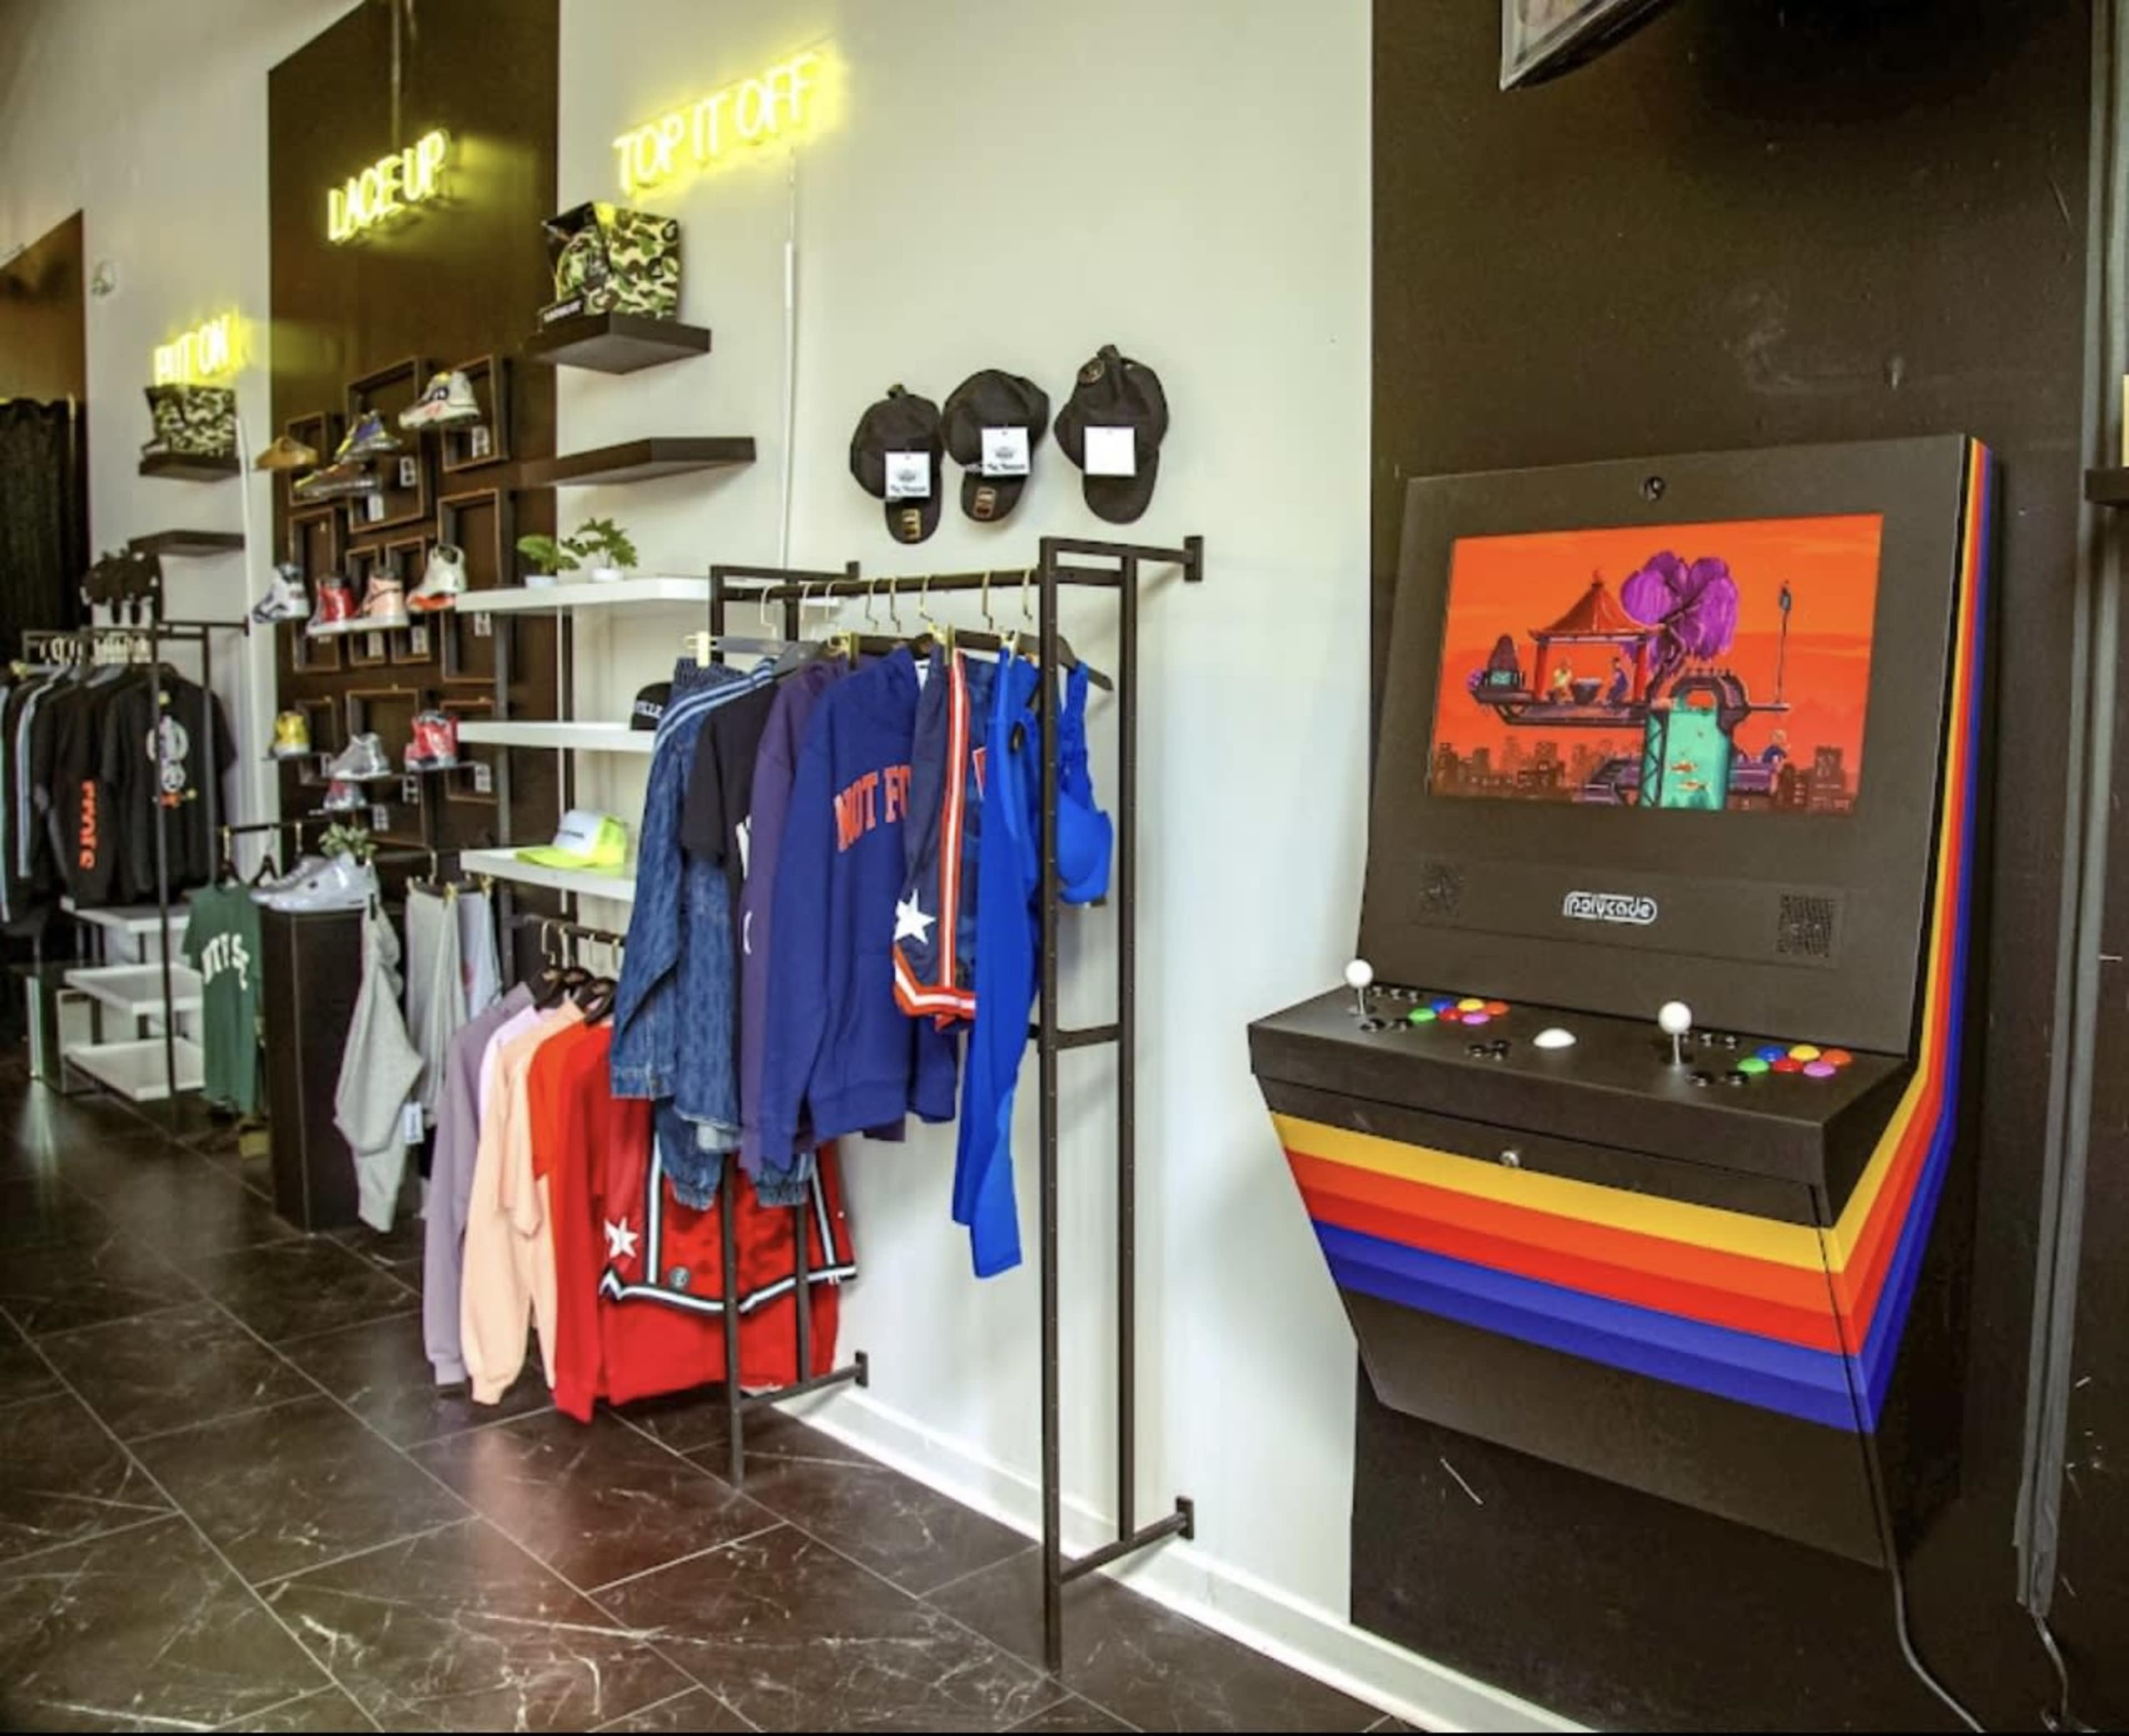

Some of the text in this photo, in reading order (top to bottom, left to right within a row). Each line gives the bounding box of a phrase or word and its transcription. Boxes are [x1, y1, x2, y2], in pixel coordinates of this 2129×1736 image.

[612, 51, 818, 196] TOP IT OFF
[328, 130, 447, 243] LACE UP
[1567, 894, 1654, 921] polycade
